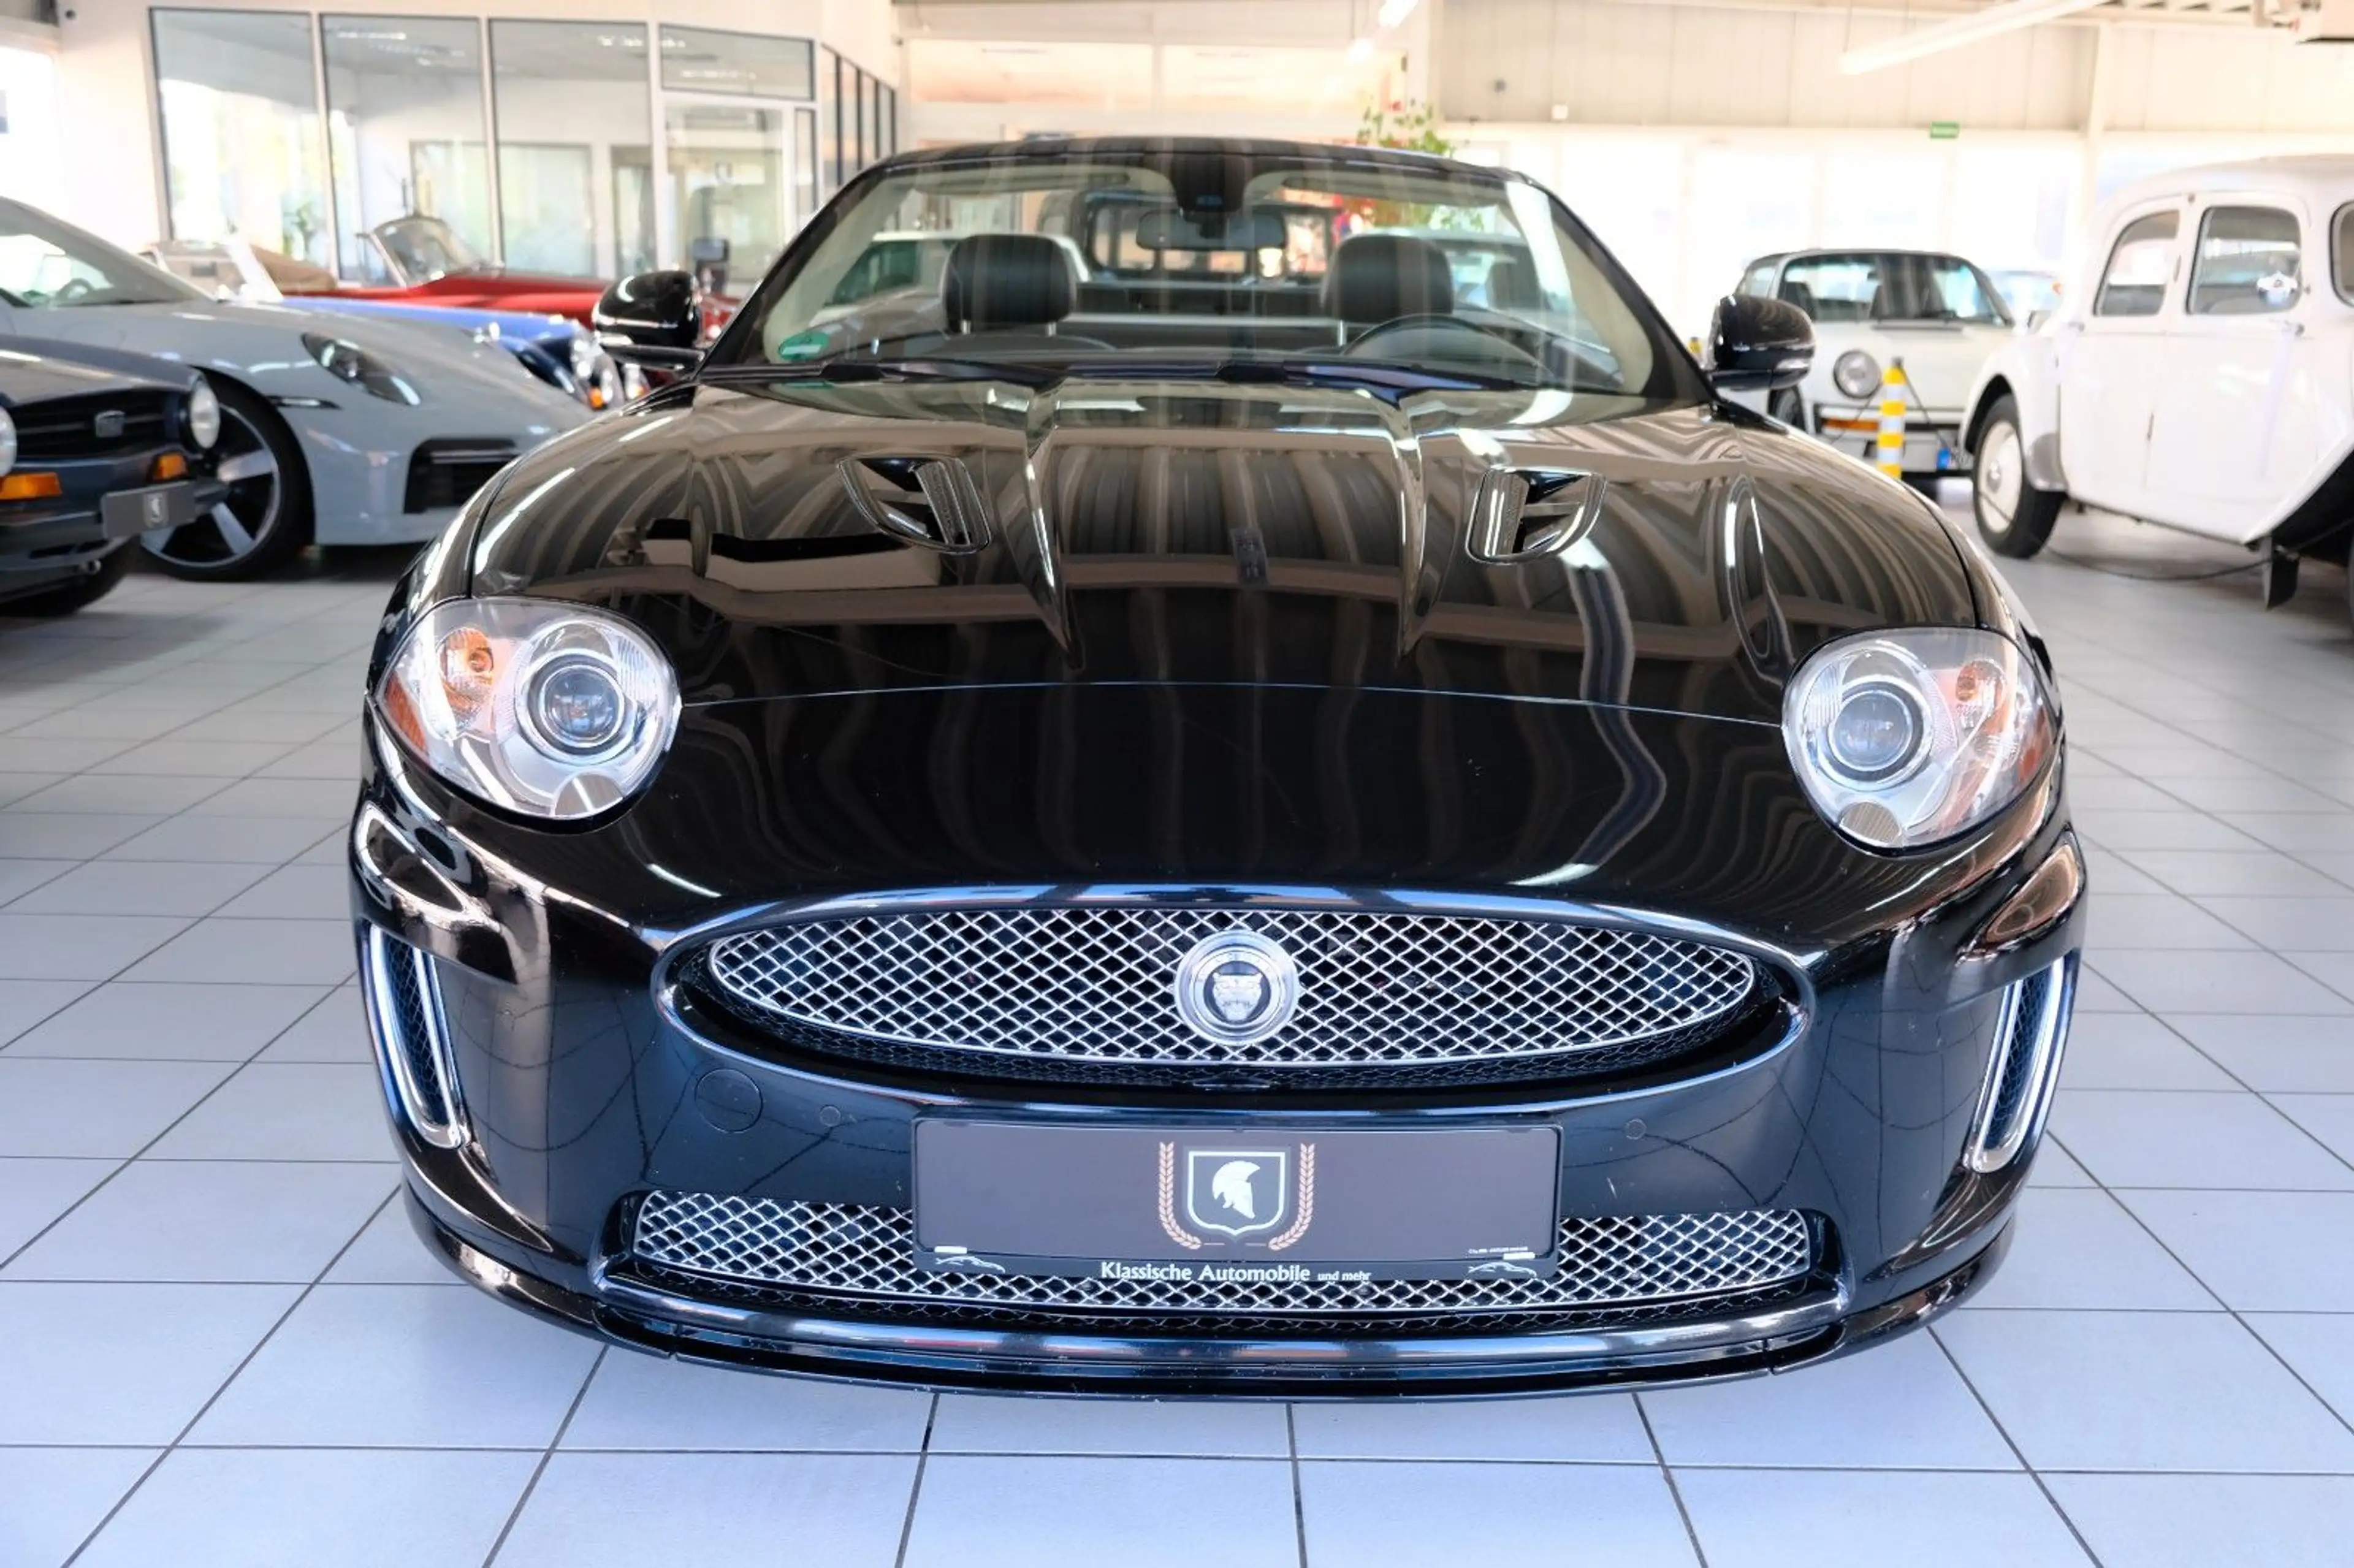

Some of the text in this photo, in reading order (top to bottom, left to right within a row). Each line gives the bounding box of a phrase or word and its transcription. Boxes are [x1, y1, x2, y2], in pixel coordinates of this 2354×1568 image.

[1101, 1262, 1371, 1282] Klassische Automobile und mehr
